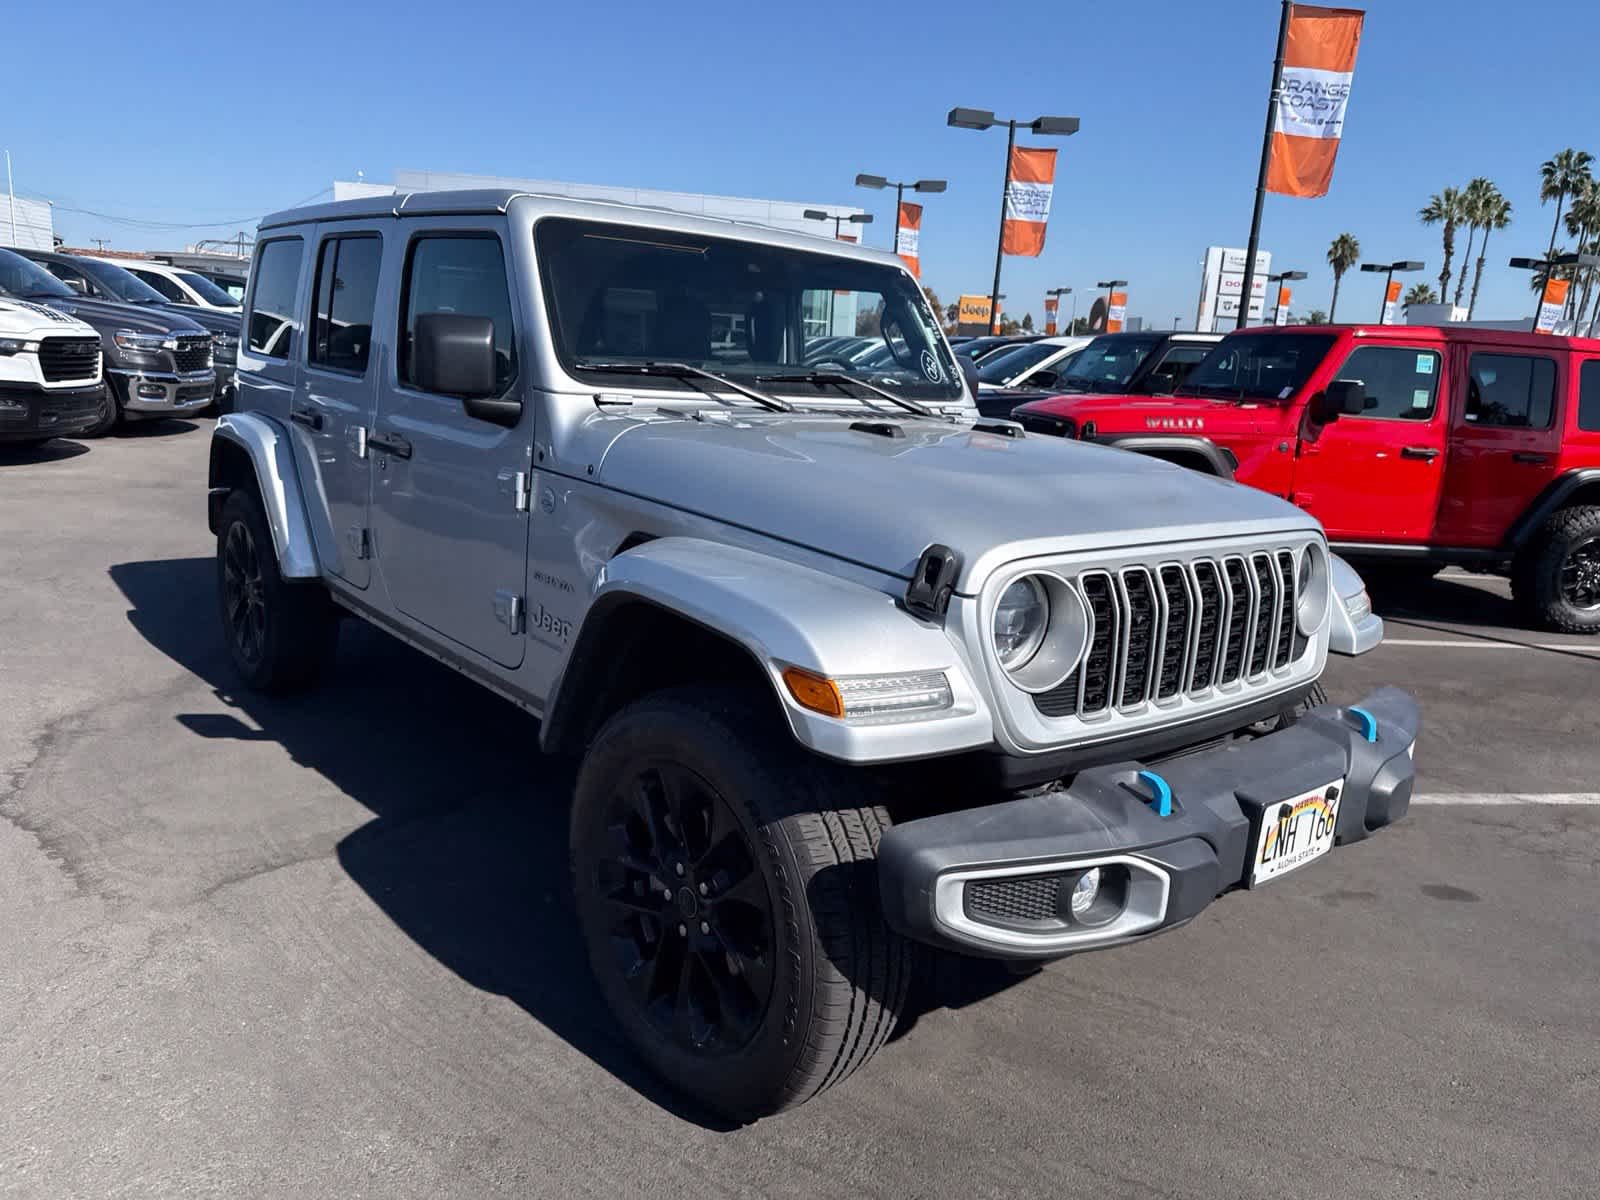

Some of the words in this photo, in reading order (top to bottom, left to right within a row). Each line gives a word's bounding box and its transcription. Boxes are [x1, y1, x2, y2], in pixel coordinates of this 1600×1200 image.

[1280, 94, 1341, 111] COAST
[961, 303, 989, 317] Jeep
[1145, 416, 1204, 430] WILLYS
[532, 602, 573, 643] Jeep
[1261, 815, 1300, 864] LNH
[1308, 800, 1337, 846] 166
